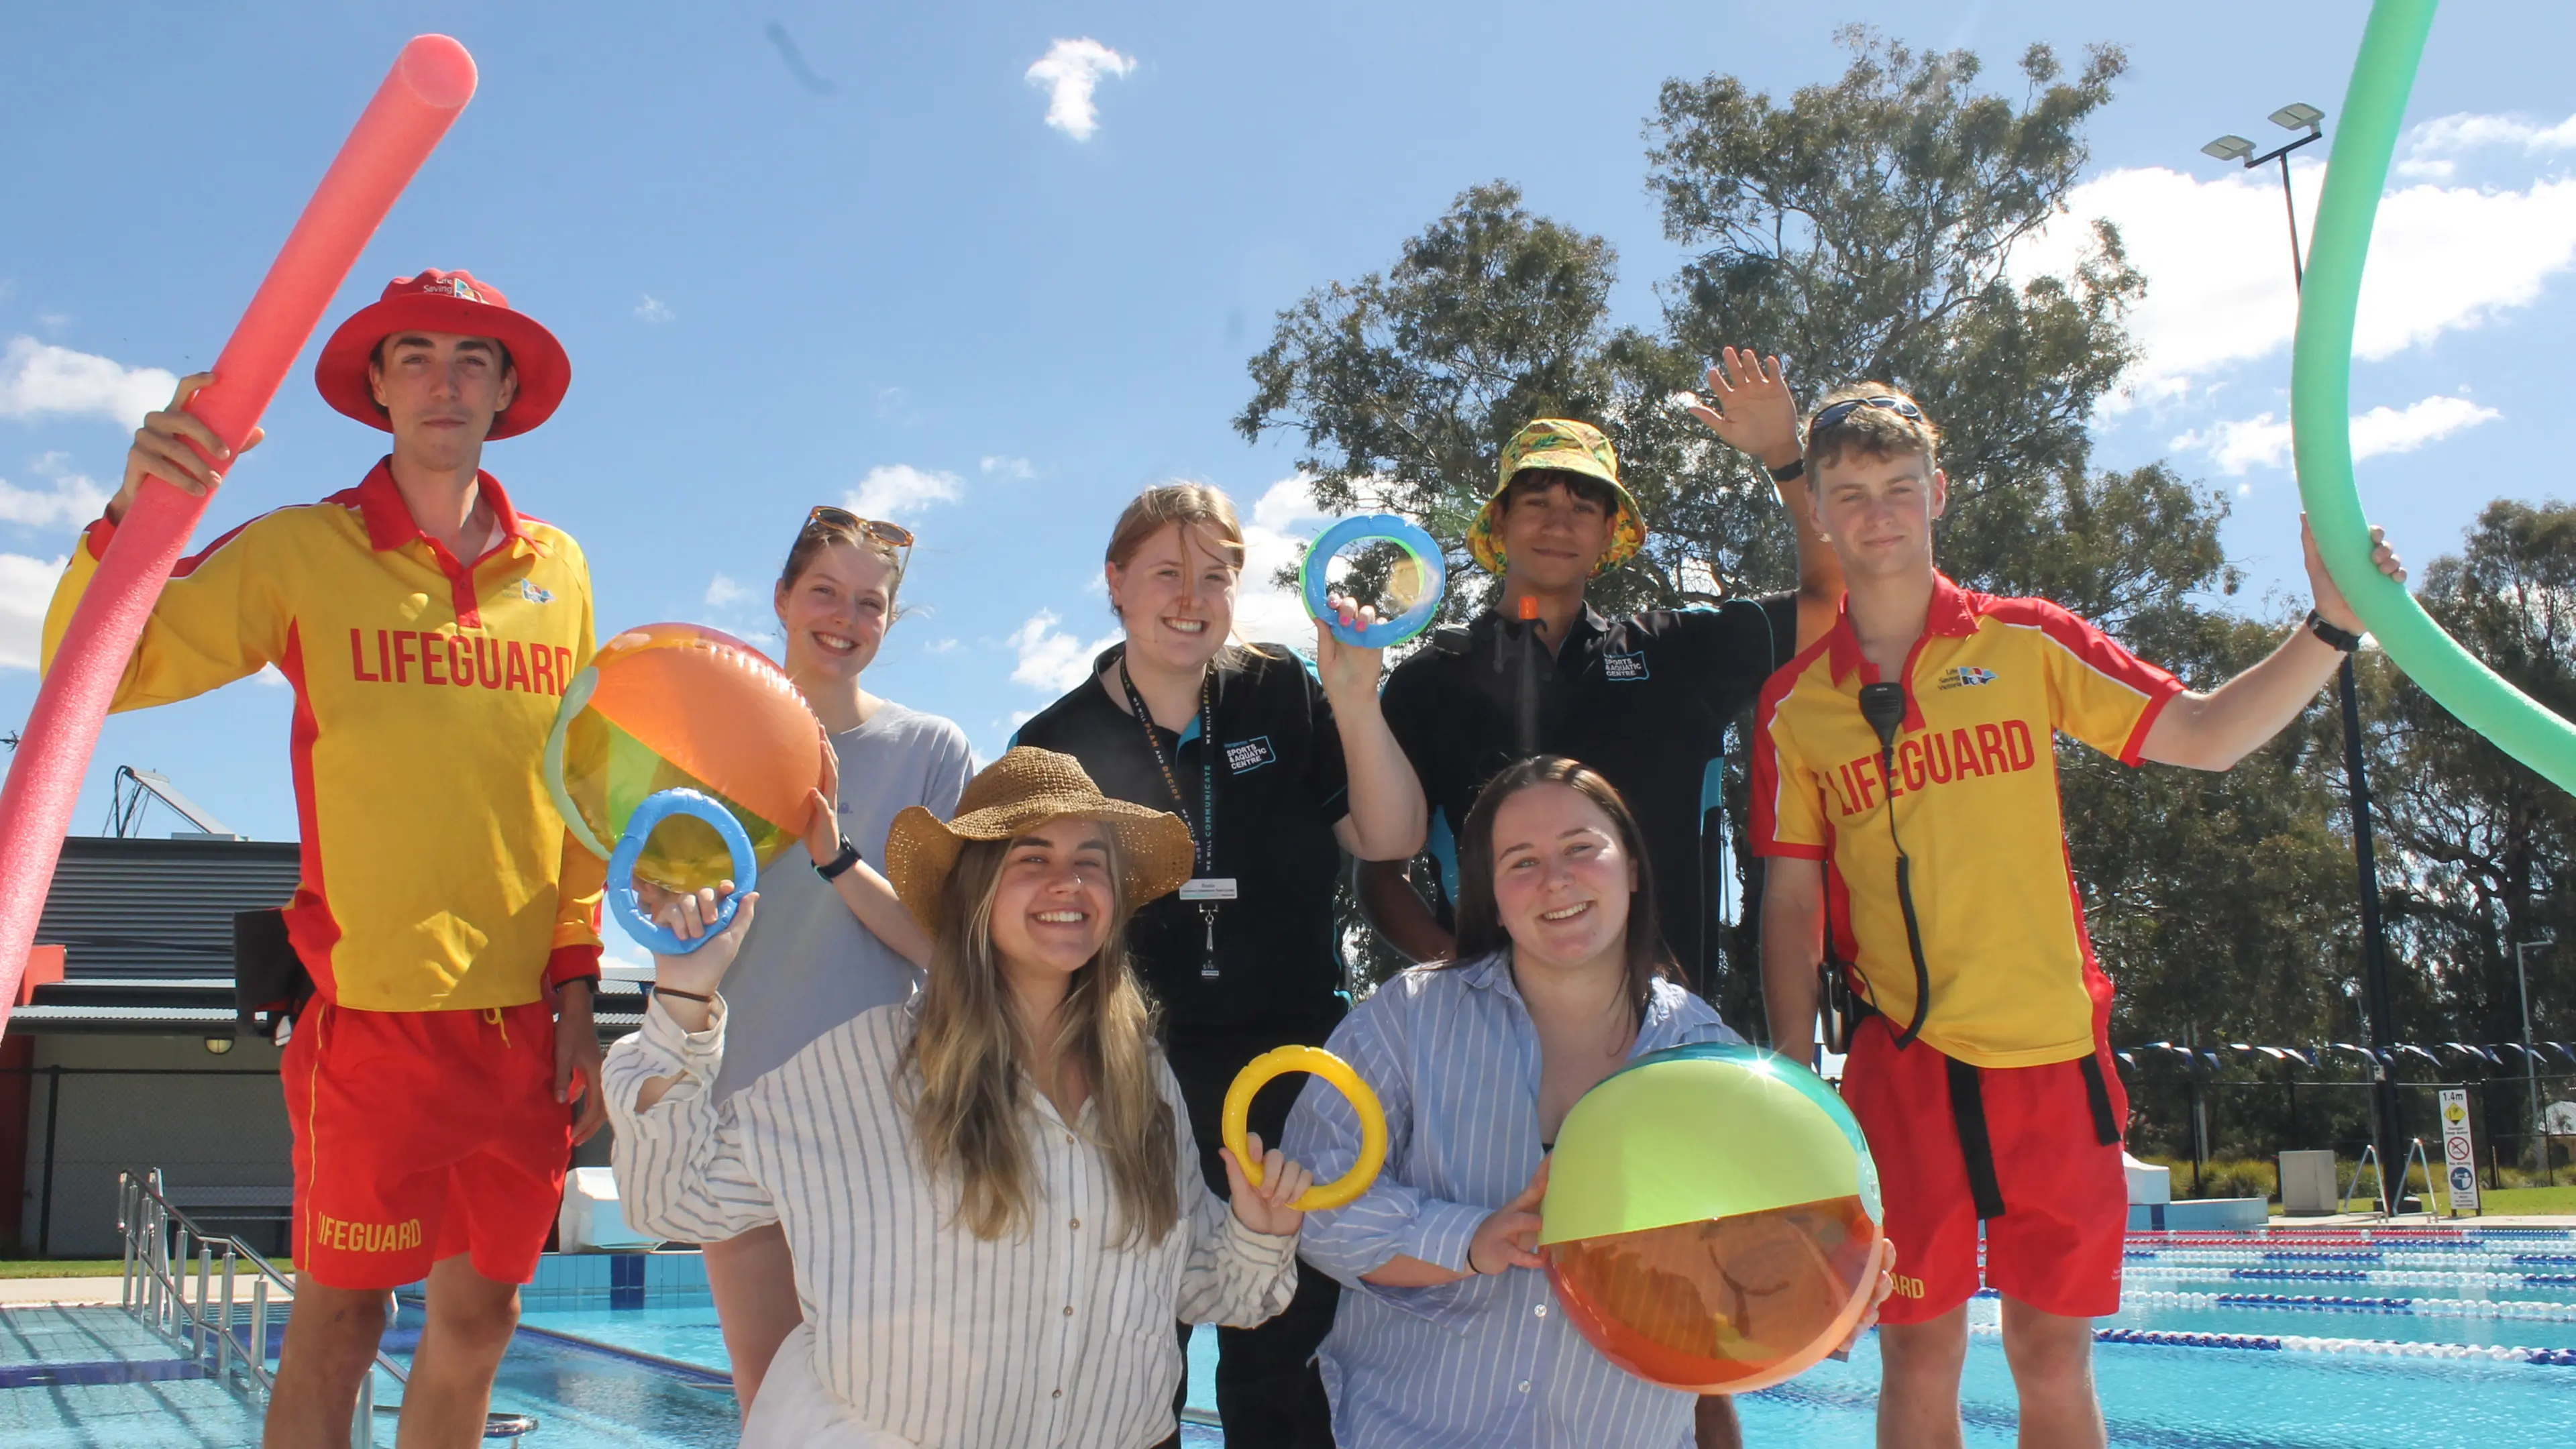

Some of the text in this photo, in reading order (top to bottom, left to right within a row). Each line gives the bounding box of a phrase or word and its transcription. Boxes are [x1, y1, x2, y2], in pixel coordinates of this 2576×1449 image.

[423, 284, 452, 294] Saving
[350, 628, 572, 697] LIFEGUARD
[1205, 733, 1211, 744] WE
[1226, 743, 1256, 757] SPORTS
[1229, 747, 1267, 763] &AQUATIC
[1144, 723, 1159, 748] PLAN
[1155, 750, 1164, 764] AND
[1162, 765, 1181, 800] DECIDE
[1231, 755, 1262, 769] CENTRE
[1825, 719, 2035, 816] LIFEGUARD
[1206, 860, 1211, 871] WE
[2443, 1091, 2464, 1102] 1.4m
